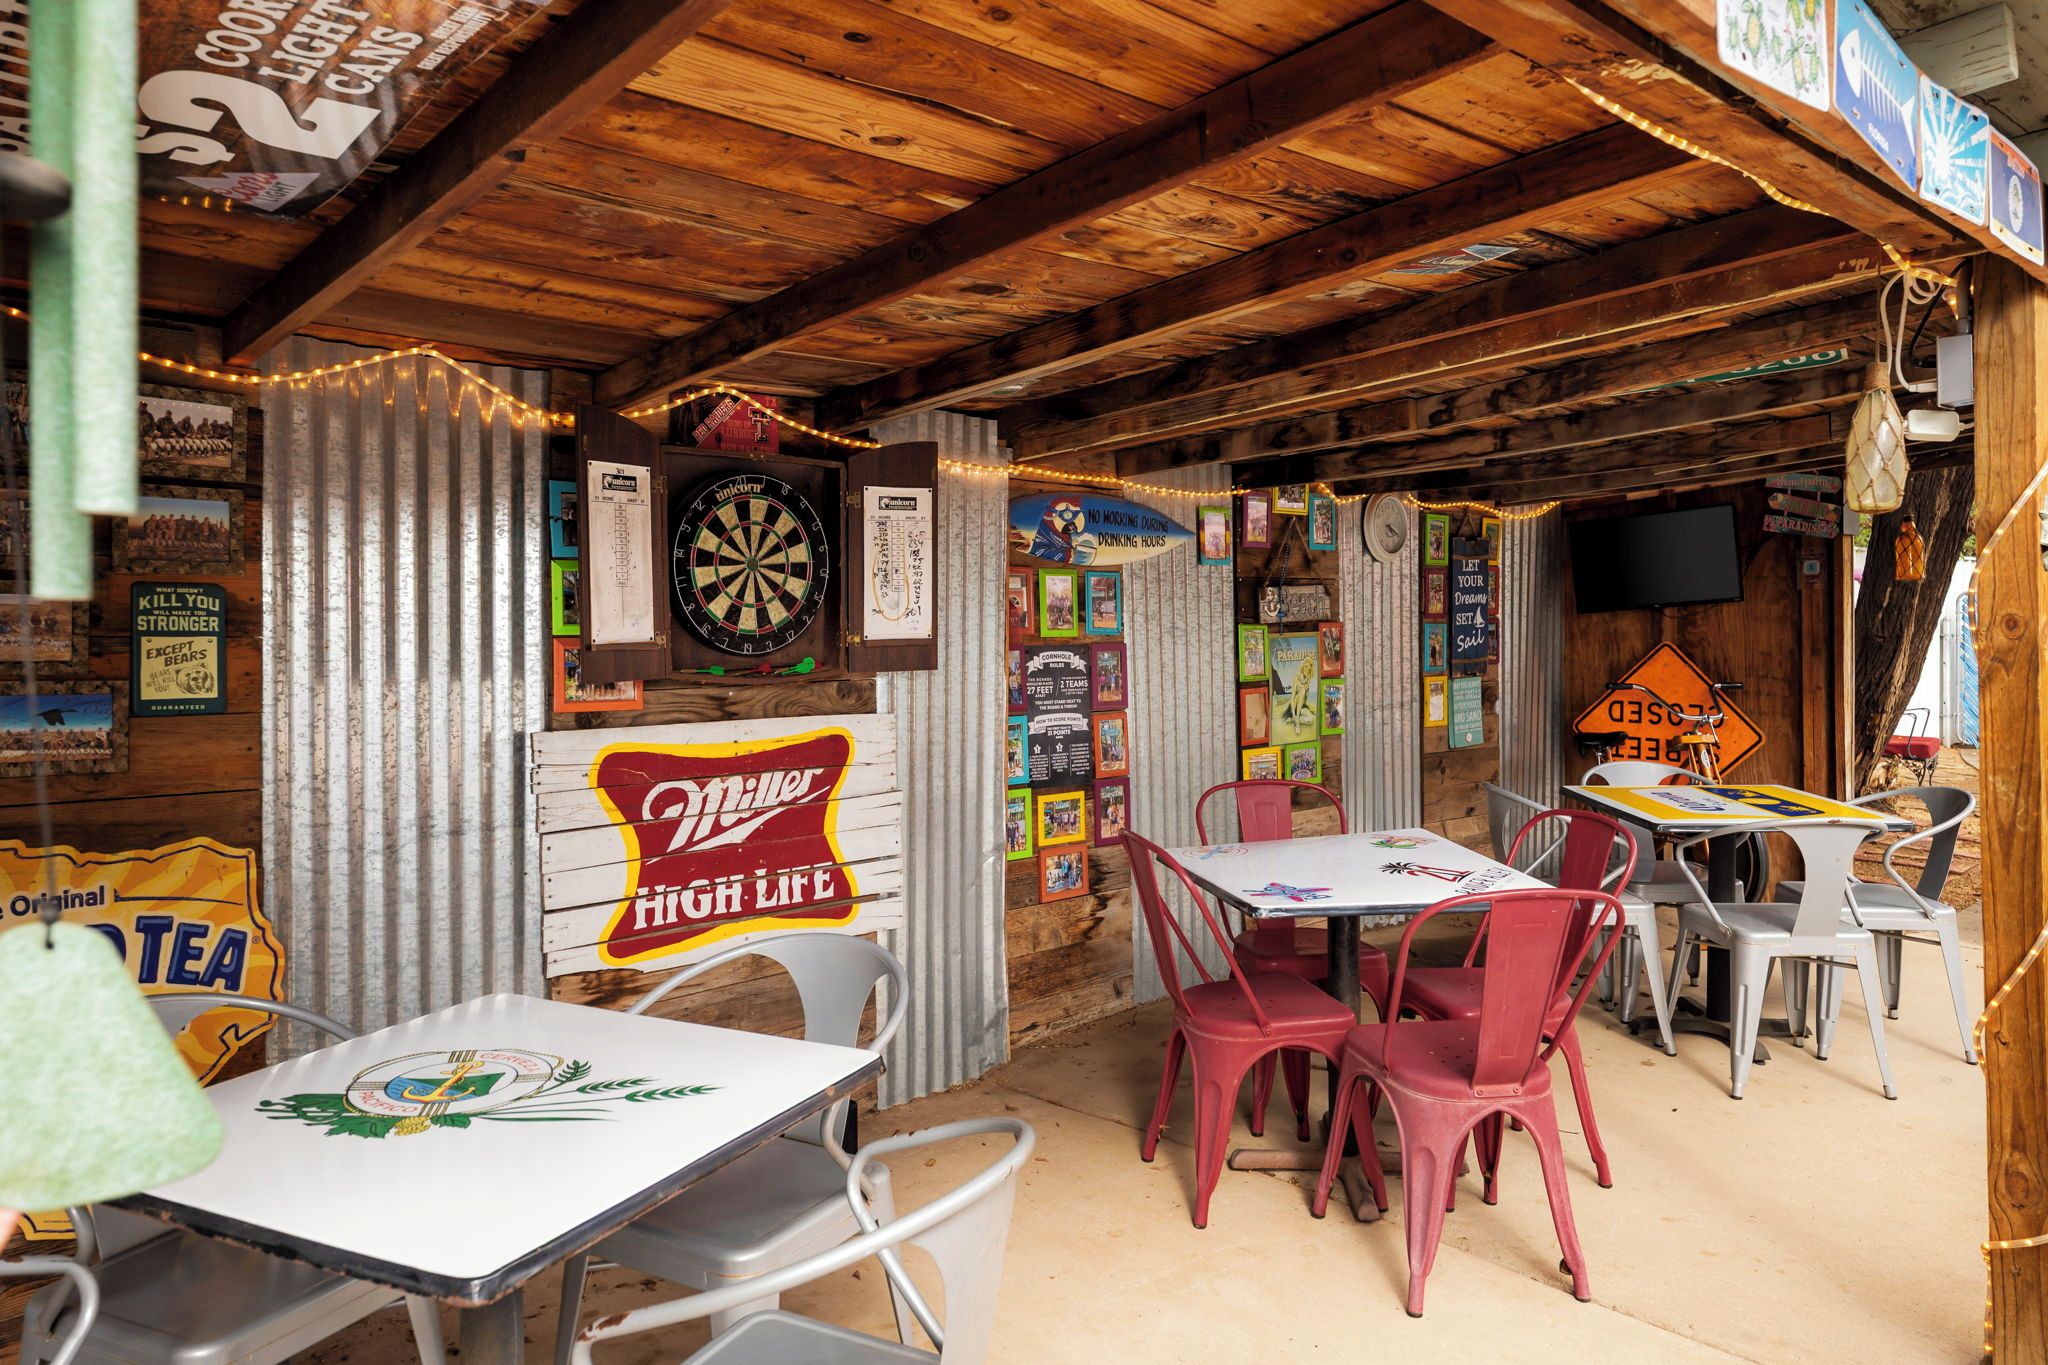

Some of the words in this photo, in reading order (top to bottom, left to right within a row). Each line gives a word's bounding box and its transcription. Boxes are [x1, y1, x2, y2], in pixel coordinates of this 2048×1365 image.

[195, 0, 297, 68] COOR
[258, 0, 370, 85] LIGHT
[325, 26, 423, 95] CANS
[692, 423, 709, 442] RED
[704, 396, 736, 430] RAIDERS
[612, 477, 636, 487] unicorn
[715, 483, 763, 502] unicorn
[889, 498, 916, 506] unicorn
[1088, 509, 1100, 524] NO
[1103, 509, 1139, 529] WORKING
[1141, 516, 1169, 534] DURING
[1098, 532, 1138, 548] DRINKING
[1141, 535, 1166, 548] HOURS
[1462, 560, 1480, 572] LET
[1458, 575, 1484, 588] YOUR
[138, 594, 182, 610] KILL
[185, 594, 220, 612] YOU
[1455, 591, 1488, 606] Dreams
[137, 615, 220, 632] STRONGER
[1456, 612, 1474, 625] SET
[146, 640, 194, 660] EXCEPT
[1457, 629, 1485, 652] Sail
[164, 649, 208, 668] BEARS
[1041, 653, 1072, 661] CORNHOLE
[1027, 686, 1036, 695] 27
[1036, 686, 1054, 694] FEET
[1066, 680, 1089, 688] TEAMS
[642, 767, 825, 852] Miller
[634, 874, 745, 930] HIGH
[754, 861, 835, 909] LIFE
[135, 915, 248, 992] TEA
[480, 1052, 540, 1072] CERVEZA
[359, 1090, 418, 1112] PACIFICO
